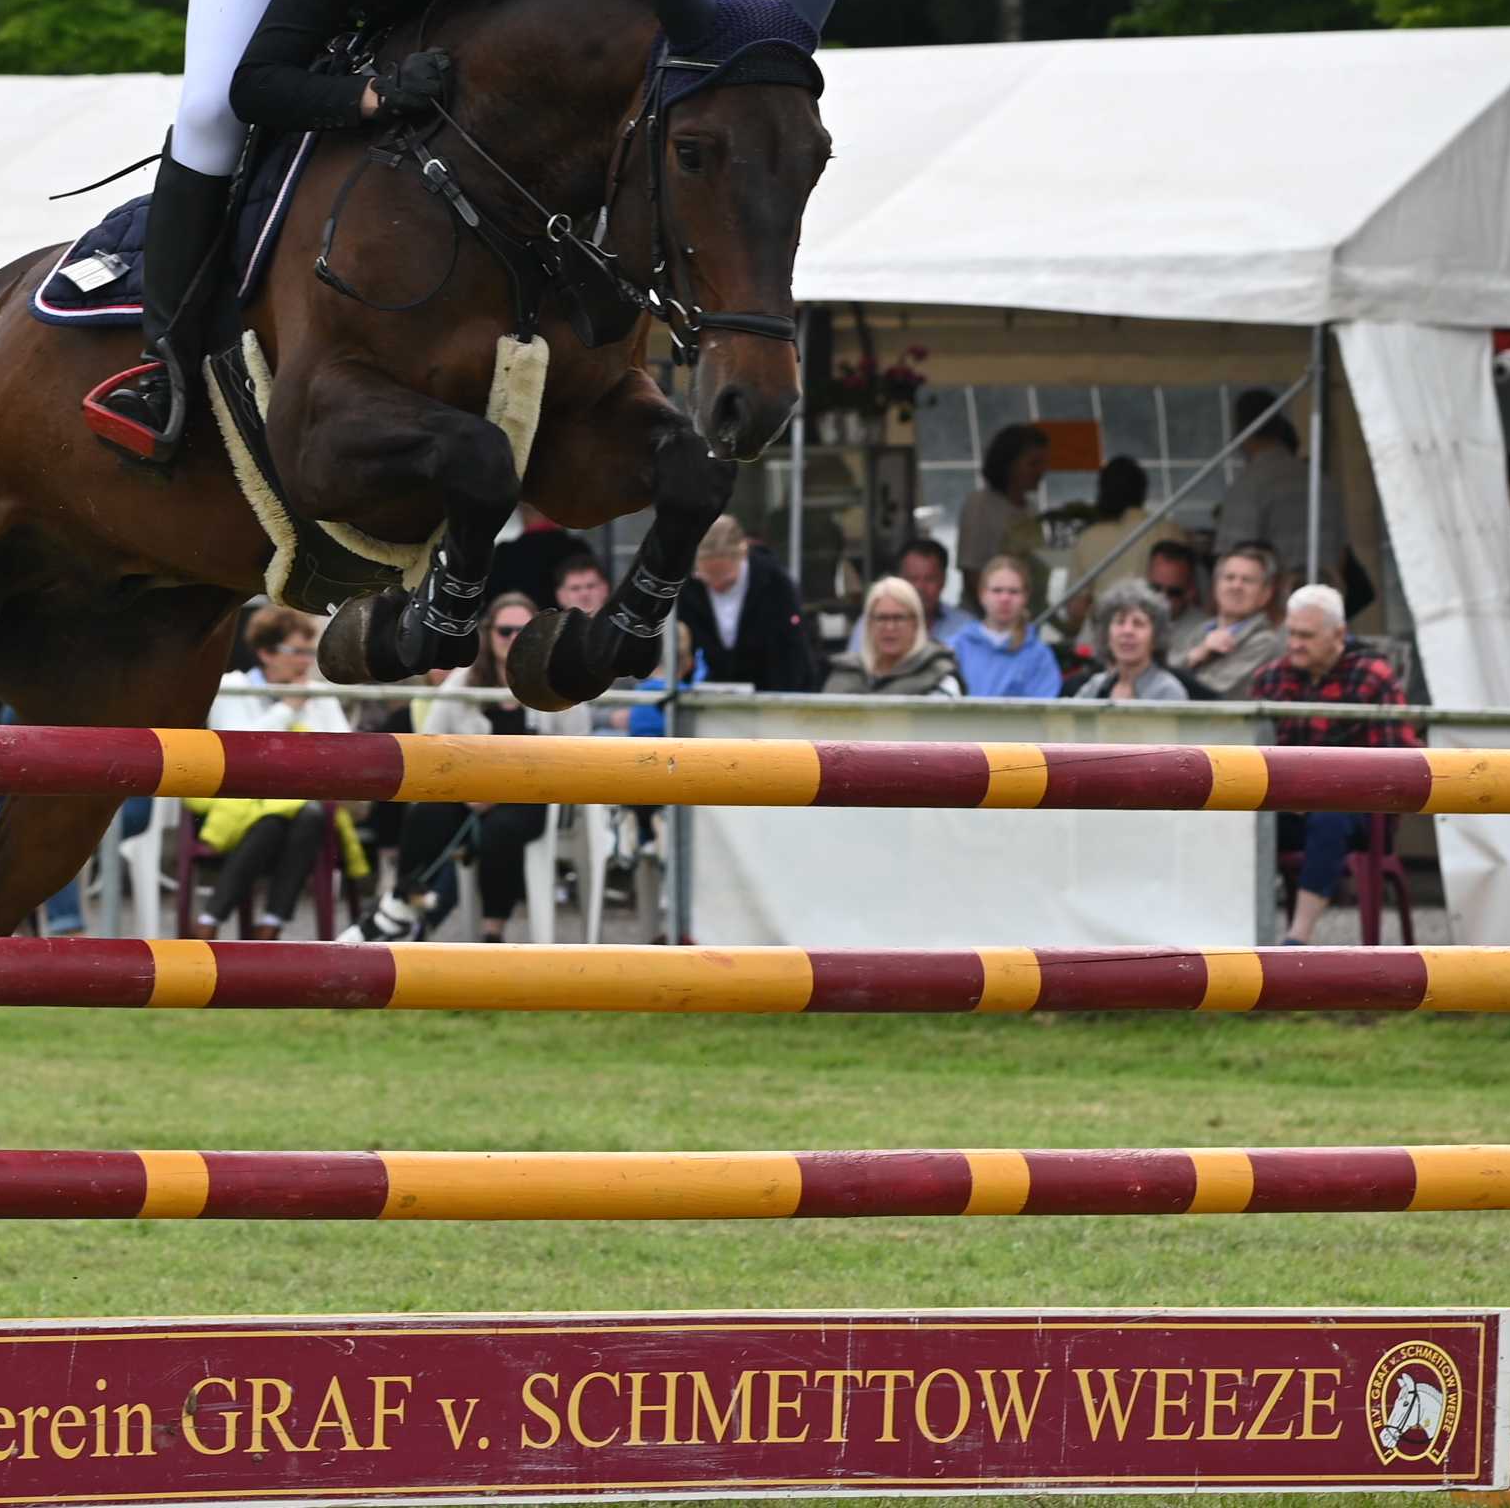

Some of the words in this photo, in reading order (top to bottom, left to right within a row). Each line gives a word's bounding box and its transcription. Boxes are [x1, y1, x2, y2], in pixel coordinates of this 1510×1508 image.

[181, 1375, 413, 1457] GRAF
[436, 1397, 489, 1450] v.
[520, 1368, 1051, 1450] SCHMETTOW
[1072, 1369, 1343, 1442] WEEZE
[1371, 1366, 1389, 1400] GRAF
[1401, 1346, 1457, 1388] SCHMETTOW
[1442, 1393, 1458, 1432] WEEZE
